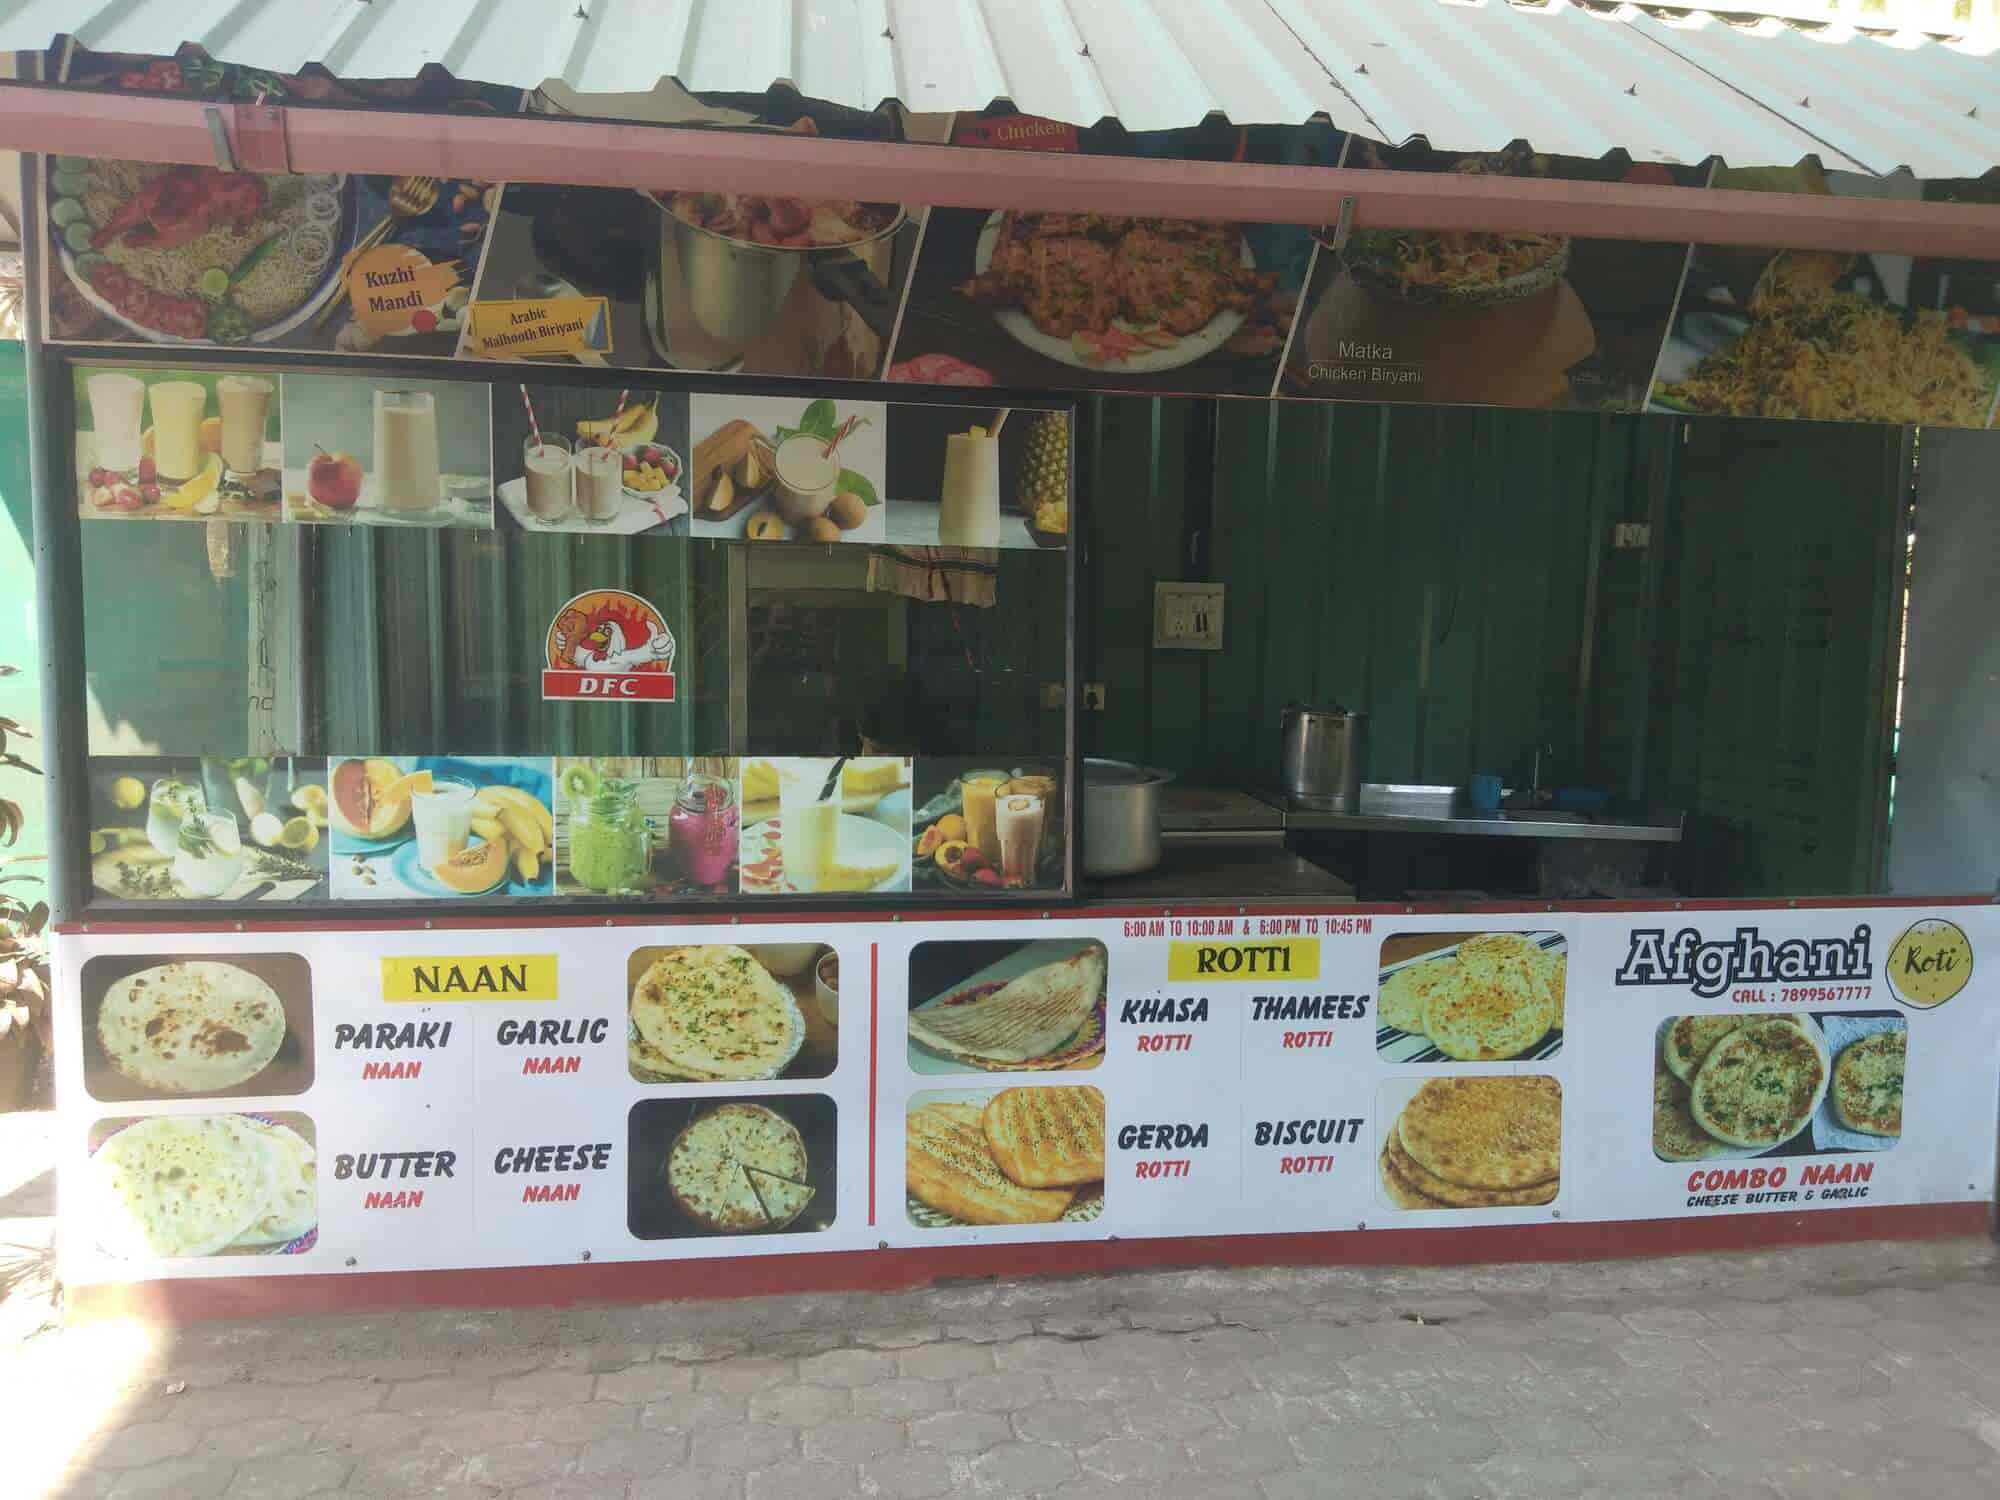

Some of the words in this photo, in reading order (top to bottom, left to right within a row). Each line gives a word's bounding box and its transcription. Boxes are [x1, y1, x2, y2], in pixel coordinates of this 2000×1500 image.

[366, 265, 416, 288] Kuzhi
[368, 290, 424, 312] Mandi
[511, 306, 547, 325] Arabic
[1338, 340, 1393, 360] Matka
[1308, 364, 1367, 380] Chicken
[1371, 367, 1424, 384] Biryani
[578, 677, 639, 695] DFC
[1124, 921, 1146, 937] 6:00
[1149, 919, 1165, 936] AM
[1170, 919, 1182, 936] TO
[1187, 919, 1214, 936] 10:00
[1218, 918, 1233, 936] AM
[1243, 920, 1250, 935] &
[1259, 919, 1282, 935] 6:00
[1285, 918, 1300, 934] PM
[1306, 918, 1319, 934] TO
[1325, 918, 1353, 934] 10:45
[1356, 917, 1372, 934] PM
[1197, 945, 1291, 973] ROTTI
[1615, 923, 1872, 998] Afghani
[413, 964, 528, 993] NAAN
[1732, 989, 1767, 1003] CALL
[1781, 985, 1872, 1002] 7899567777
[1120, 998, 1209, 1023] KHASA
[1252, 995, 1370, 1020] THAMEES
[334, 1021, 453, 1050] PARAKI
[497, 1018, 609, 1046] GARLIC
[1283, 1031, 1333, 1048] ROTTI
[1137, 1034, 1192, 1052] ROTTI
[362, 1061, 422, 1080] NAAN
[523, 1056, 581, 1075] NAAN
[1118, 1124, 1208, 1150] GERDA
[1254, 1118, 1364, 1146] BISCUIT
[335, 1150, 457, 1180] BUTTER
[494, 1143, 612, 1174] CHEESE
[1280, 1156, 1334, 1174] ROTTI
[1136, 1160, 1191, 1179] ROTTI
[1688, 1166, 1787, 1192] COMBO
[1800, 1162, 1874, 1186] NAAN
[364, 1191, 424, 1209] NAAN
[522, 1183, 581, 1203] NAAN
[1687, 1194, 1739, 1207] CHEESE
[1745, 1191, 1798, 1203] BUTTER
[1804, 1189, 1813, 1200] &
[1821, 1186, 1869, 1200] GARLIC
